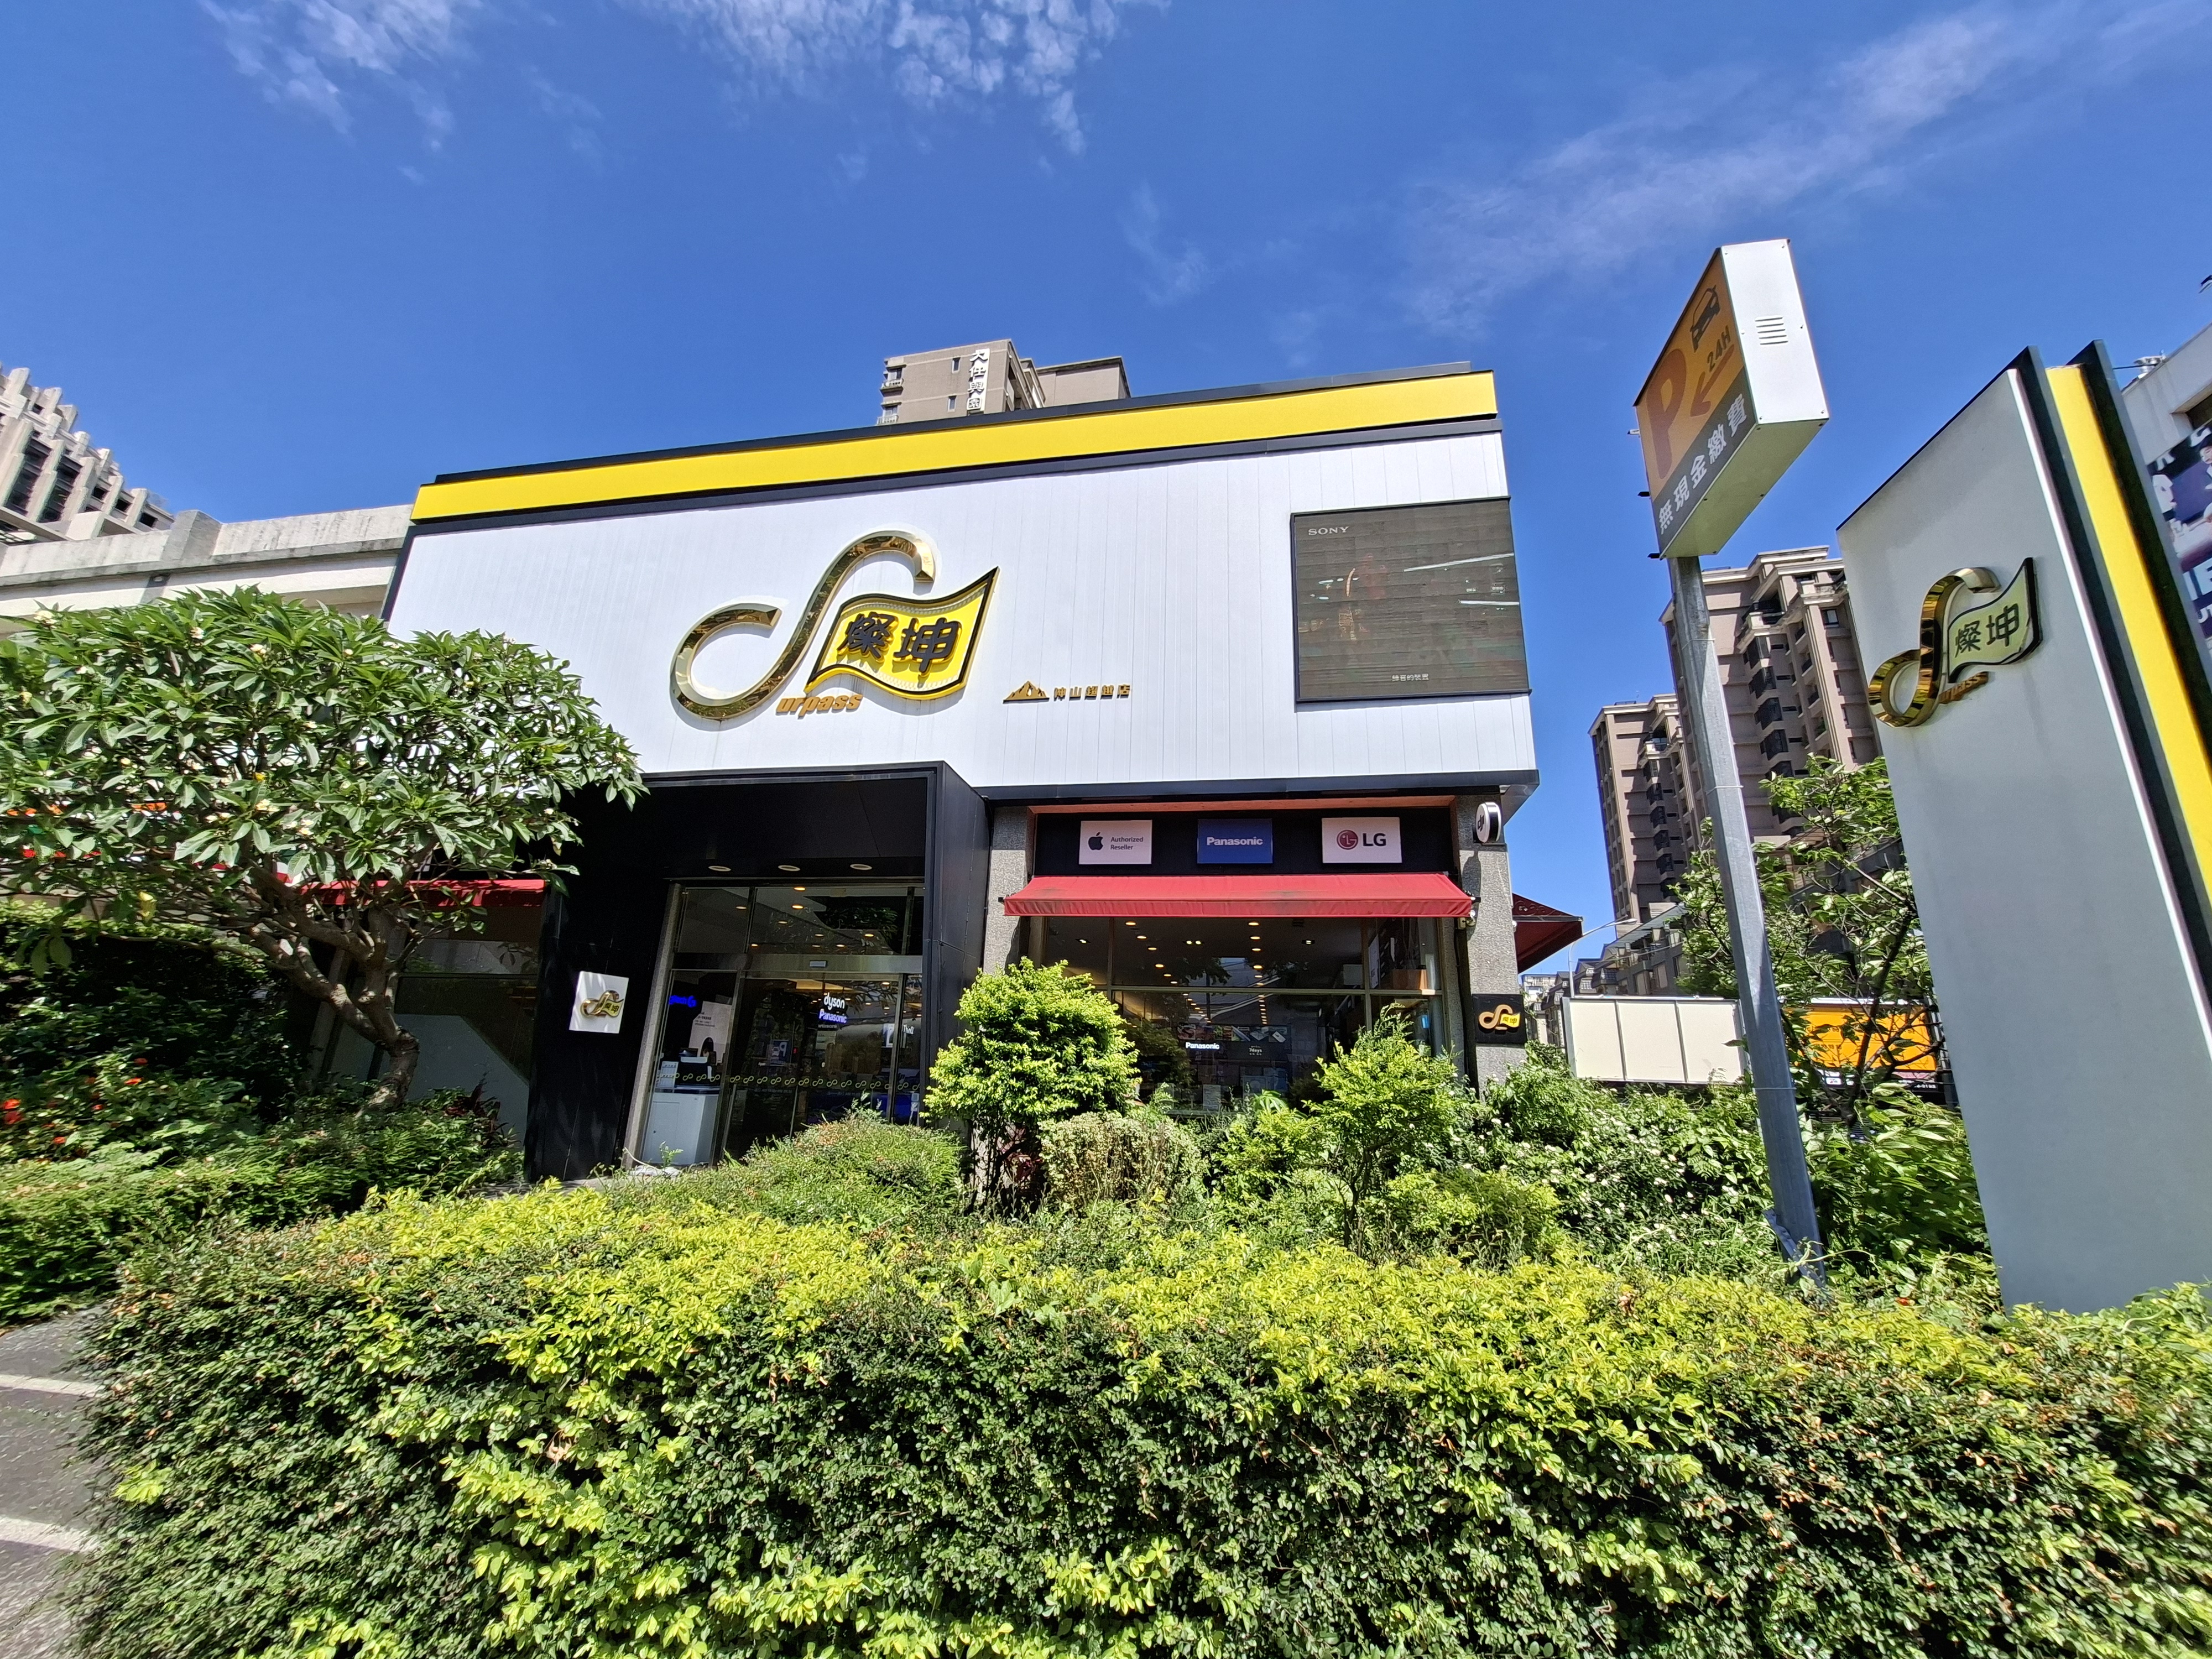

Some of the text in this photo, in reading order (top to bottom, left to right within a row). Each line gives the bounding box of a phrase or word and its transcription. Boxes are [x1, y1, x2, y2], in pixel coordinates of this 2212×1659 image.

[1707, 325, 1731, 373] 24H
[1646, 348, 1687, 479] P
[1659, 393, 1747, 535] 無現金繳費
[1308, 526, 1350, 536] SONY
[1954, 603, 2020, 659] 燦坤
[837, 611, 962, 674] 燦坤
[1207, 836, 1264, 846] Panasonic
[1362, 832, 1386, 847] LG
[823, 992, 846, 1010] dyson
[818, 1009, 847, 1024] Panasonic
[1186, 1042, 1220, 1050] Panasonic
